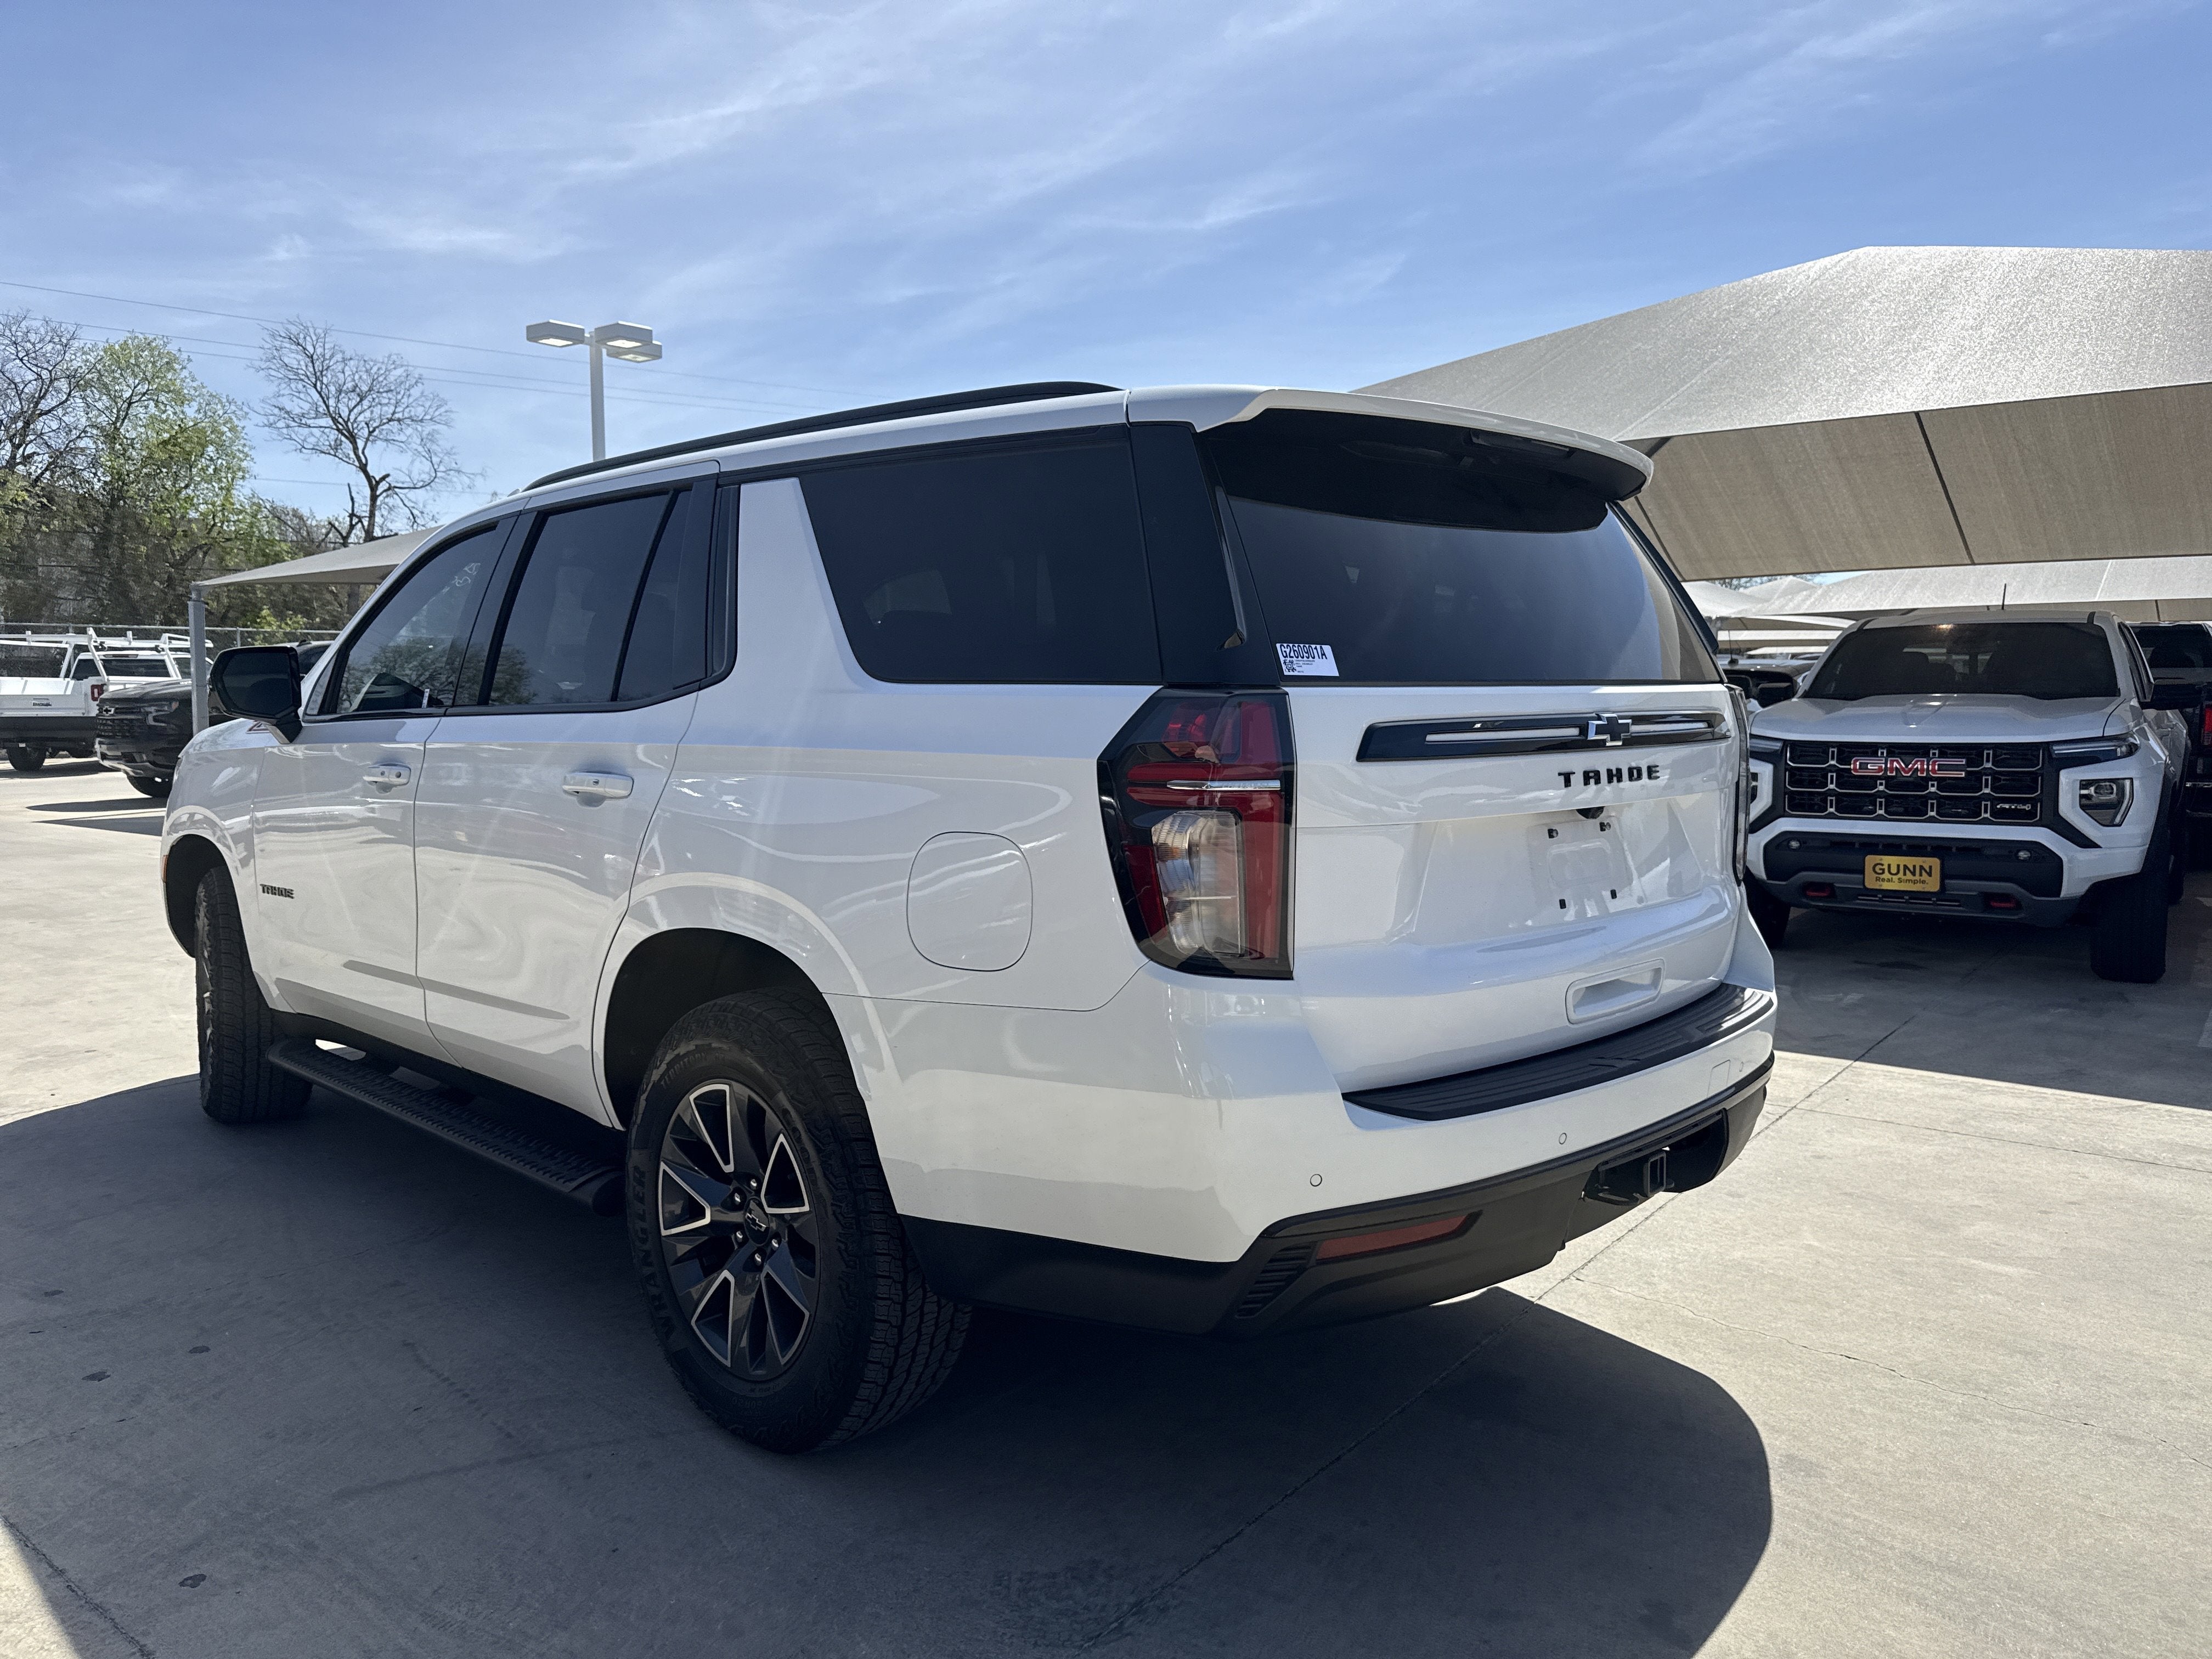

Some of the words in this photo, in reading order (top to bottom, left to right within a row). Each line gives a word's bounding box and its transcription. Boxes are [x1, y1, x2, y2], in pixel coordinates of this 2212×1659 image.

[1279, 644, 1328, 659] G260901A
[1850, 757, 1966, 777] GMC
[1558, 764, 1660, 788] TAHOE
[1872, 862, 1933, 877] GUNN
[1897, 877, 1929, 885] Simple.
[632, 1163, 676, 1342] WRANGLER
